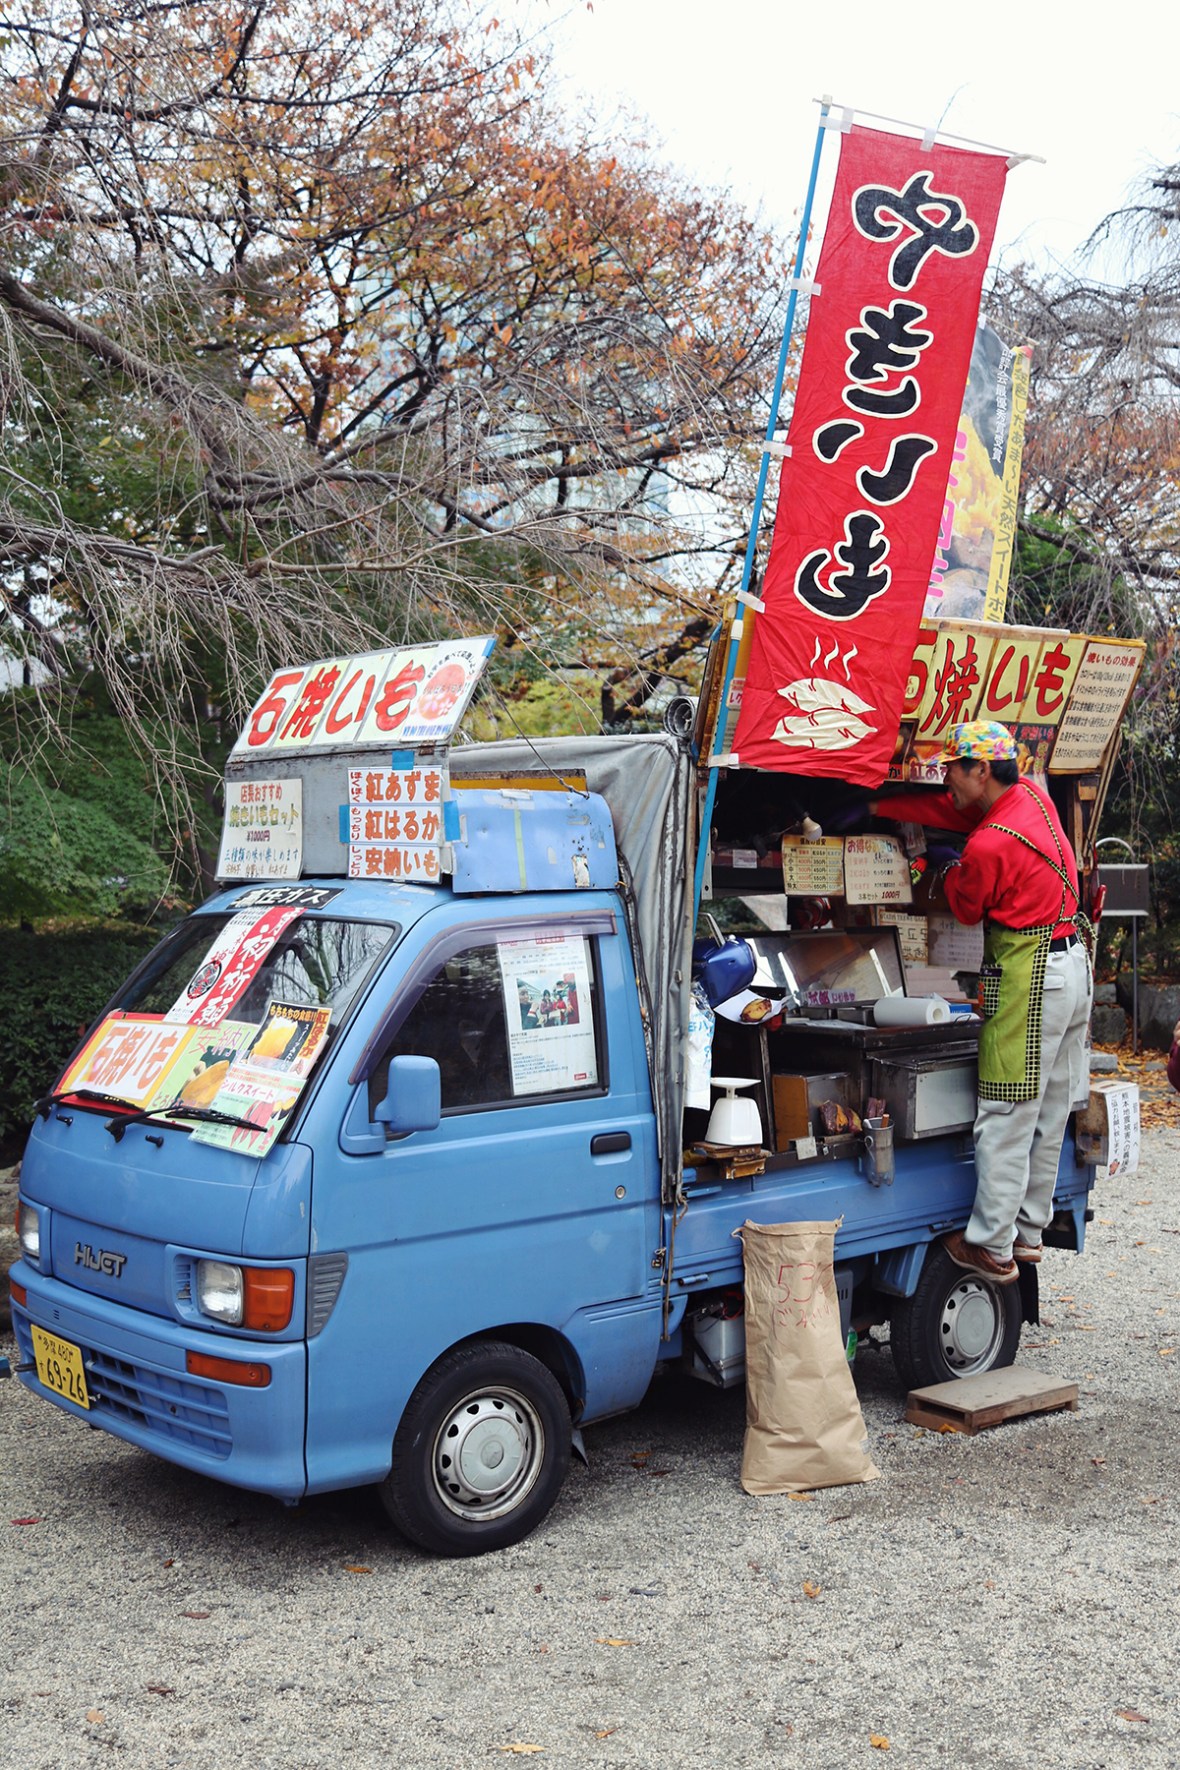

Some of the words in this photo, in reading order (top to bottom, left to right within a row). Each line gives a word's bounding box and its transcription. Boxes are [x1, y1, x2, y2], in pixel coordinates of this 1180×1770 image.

[1086, 652, 1137, 667] 焼いもの効果
[247, 659, 427, 746] 石焼いも
[241, 784, 282, 803] 店長おすすめ
[350, 771, 362, 803] ほくほく
[365, 770, 440, 802] 紅あずま
[229, 803, 299, 828] 焼きいもセット
[351, 807, 362, 840] もっちり
[365, 809, 440, 840] 紅はるか
[351, 846, 362, 876] しっとり
[365, 847, 439, 877] 安納いも
[231, 886, 330, 908] 高圧ガス
[882, 890, 901, 899] 1000円
[88, 1026, 179, 1089] 石焼いも
[221, 1080, 274, 1100] シルクスイート
[46, 1357, 85, 1402] 69-26
